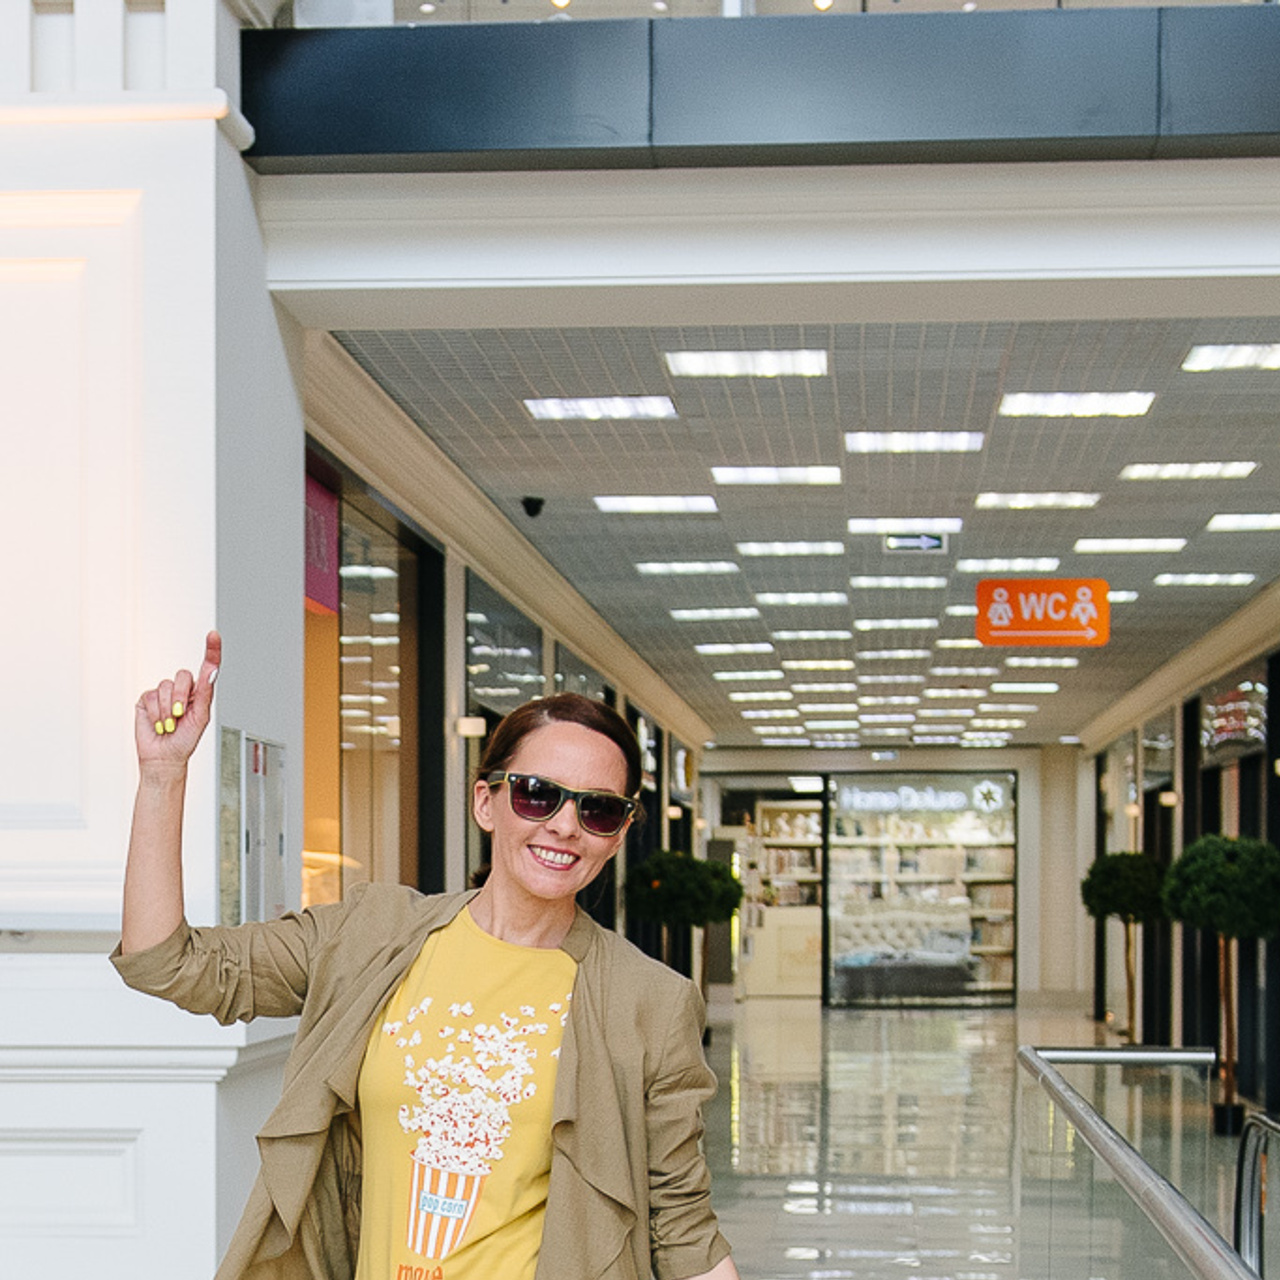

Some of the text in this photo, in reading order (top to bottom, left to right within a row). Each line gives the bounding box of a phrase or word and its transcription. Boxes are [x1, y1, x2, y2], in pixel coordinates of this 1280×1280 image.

[1018, 592, 1067, 621] WC
[421, 1195, 464, 1215] pop corn
